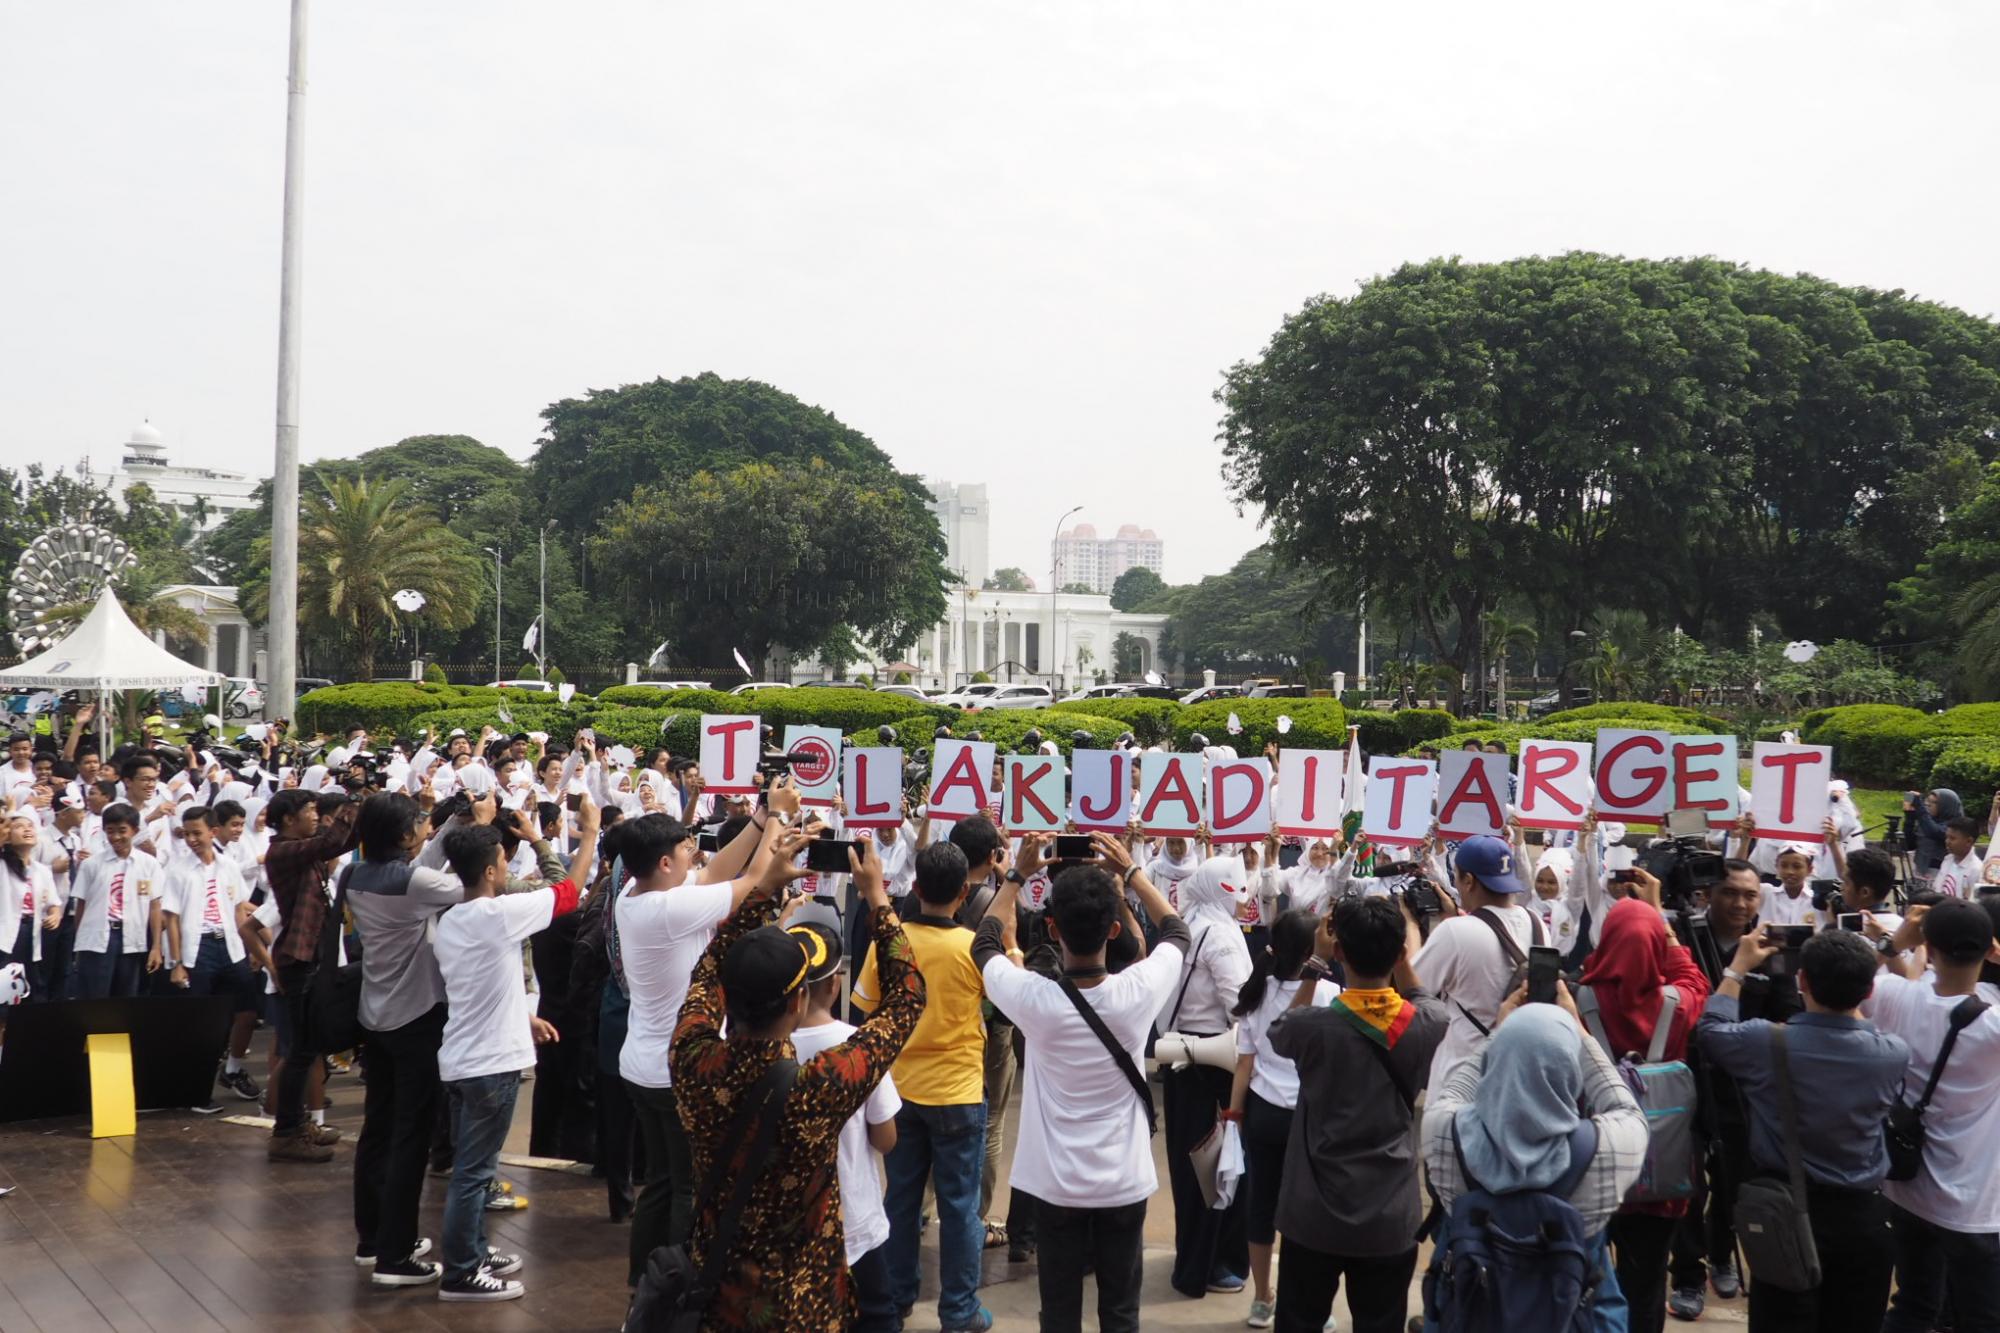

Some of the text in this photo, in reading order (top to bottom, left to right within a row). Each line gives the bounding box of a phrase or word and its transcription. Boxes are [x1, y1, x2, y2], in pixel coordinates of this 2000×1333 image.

[706, 720, 754, 781] T
[931, 746, 987, 811] A
[1521, 745, 1584, 816] R
[1597, 735, 1667, 808] G
[1673, 742, 1729, 811] E
[855, 754, 890, 815] L
[1011, 762, 1059, 825] K
[1081, 754, 1123, 821] J
[1142, 758, 1200, 824] A
[1213, 763, 1264, 830] D
[1302, 756, 1318, 822] I
[1376, 765, 1428, 830] T
[1440, 757, 1504, 830] A
[1762, 751, 1823, 825] T
[1500, 855, 1510, 874] I
